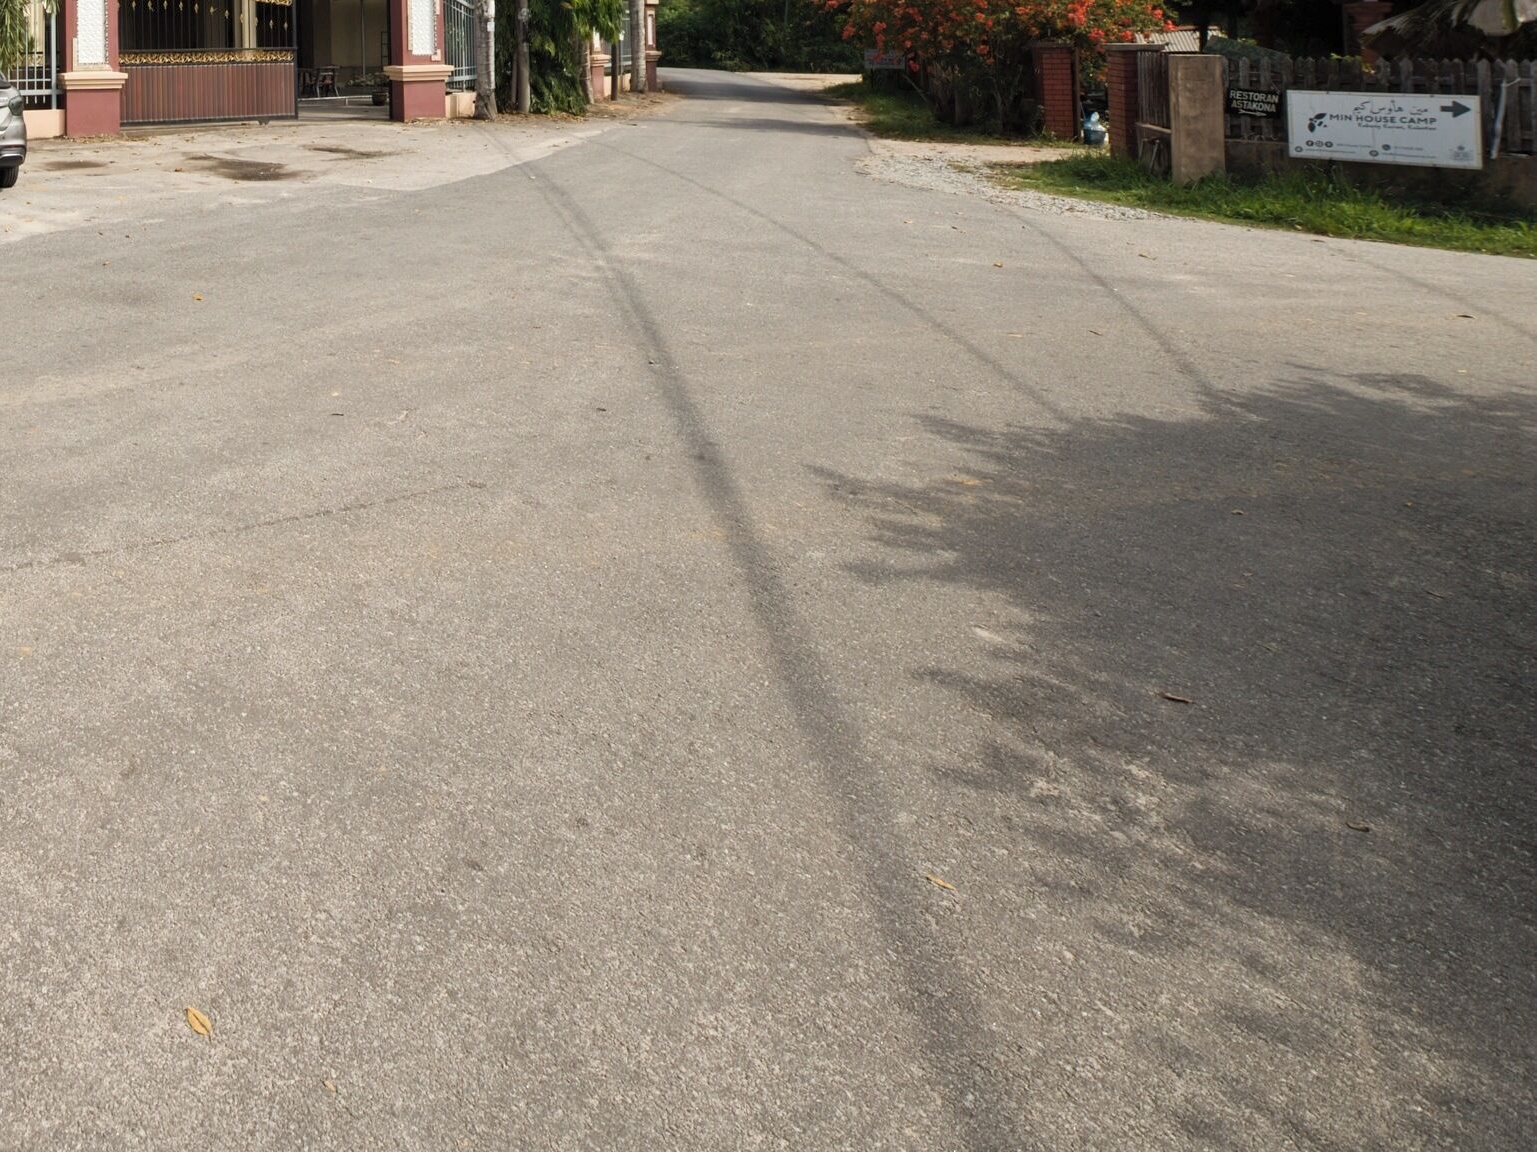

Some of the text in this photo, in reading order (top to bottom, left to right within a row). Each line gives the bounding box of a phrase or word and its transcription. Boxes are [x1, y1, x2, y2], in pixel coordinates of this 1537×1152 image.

[1229, 89, 1279, 104] RESTORAN
[1230, 100, 1277, 113] ASTAKONA
[1355, 115, 1397, 125] HOUSE
[1399, 116, 1438, 126] CAMP
